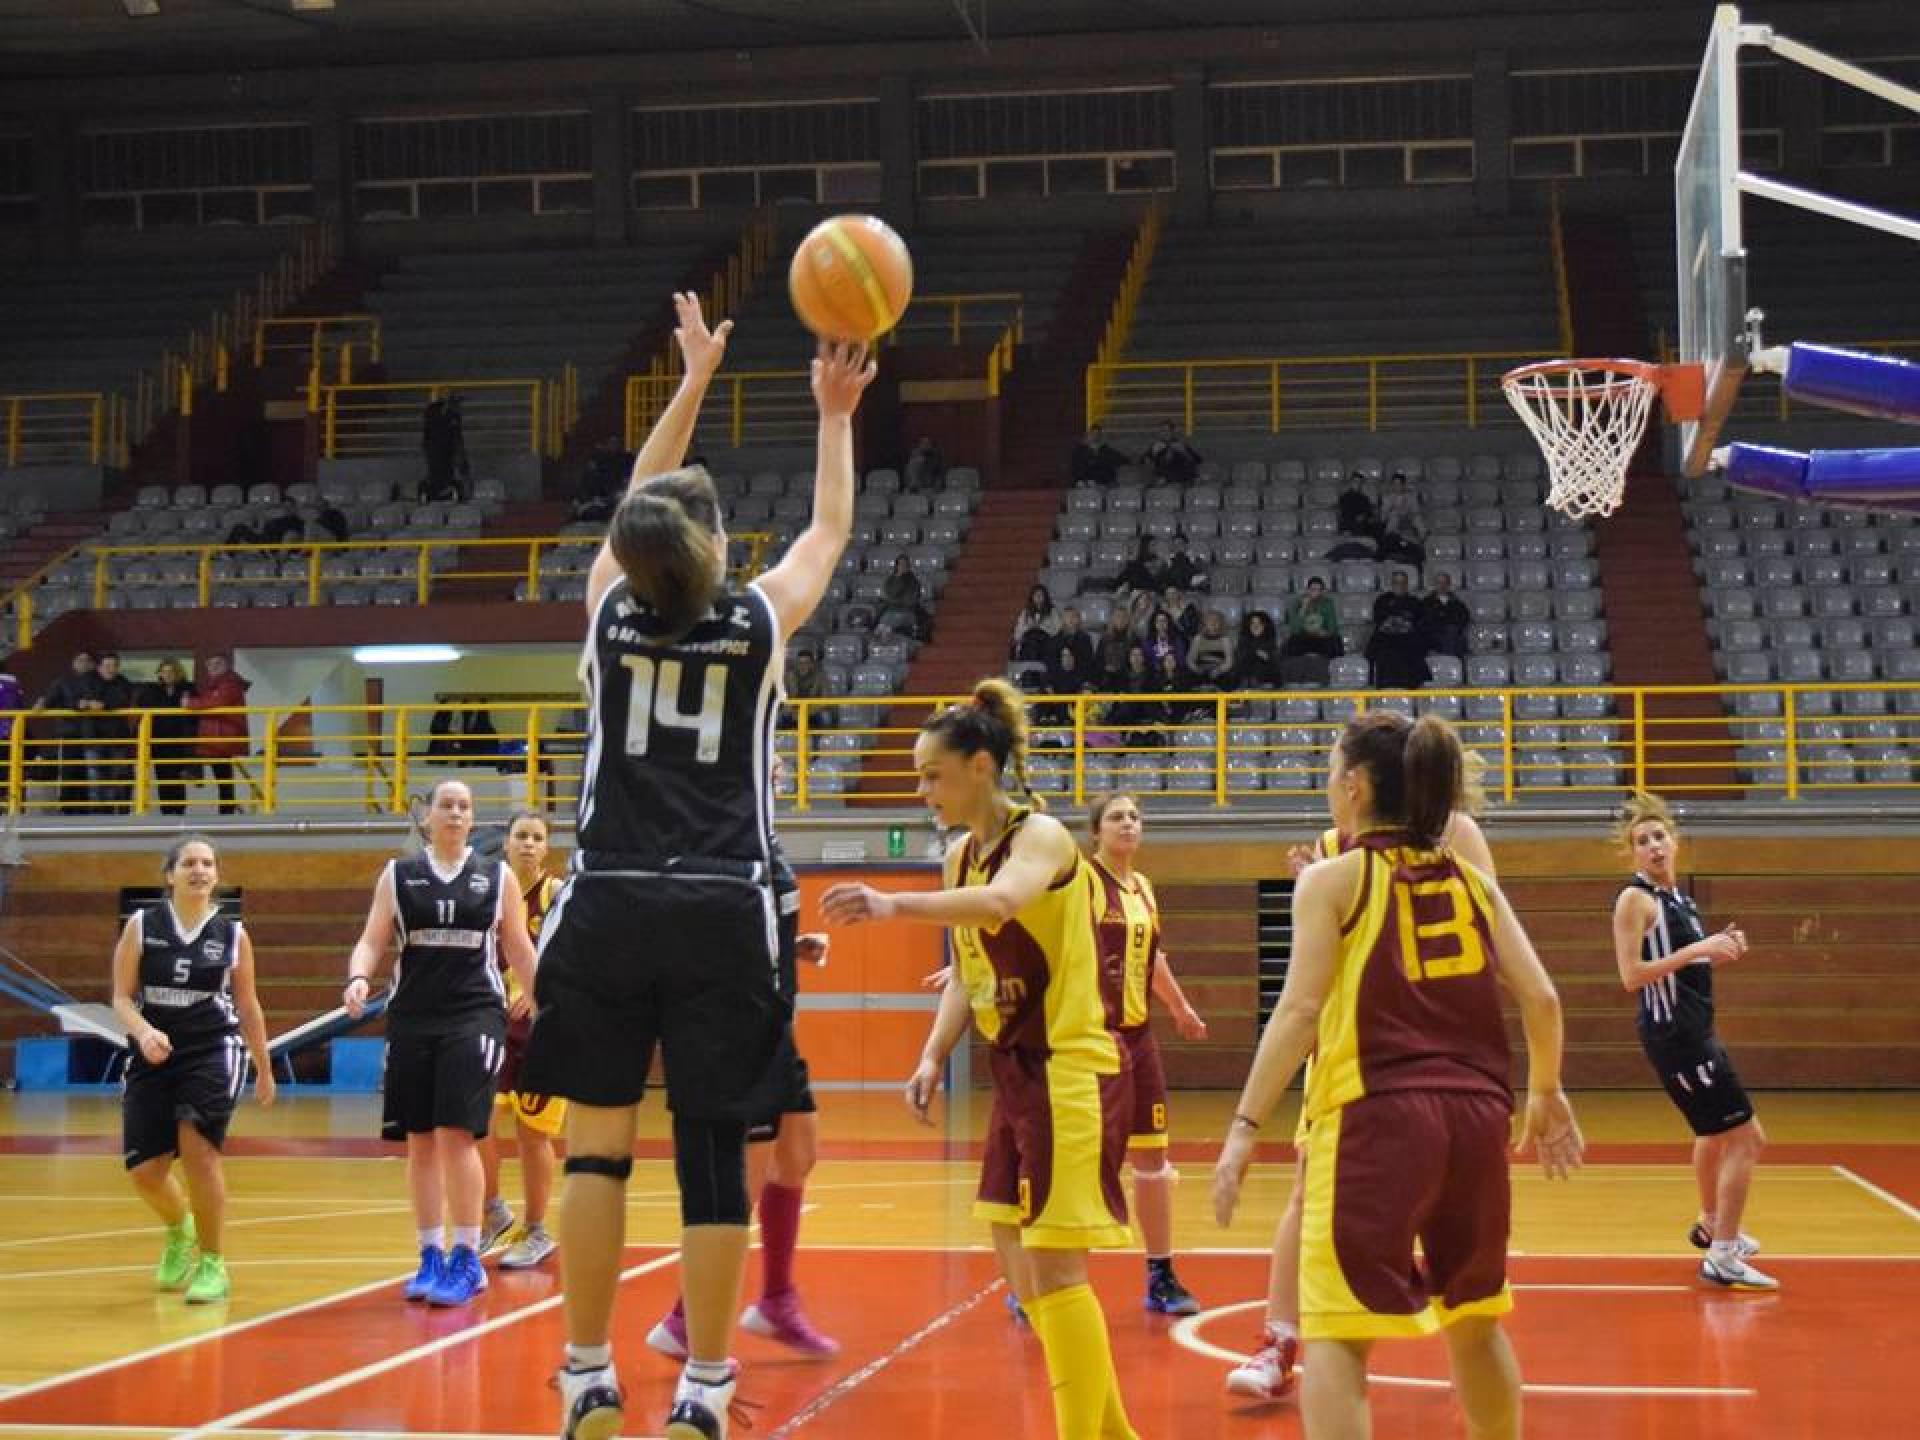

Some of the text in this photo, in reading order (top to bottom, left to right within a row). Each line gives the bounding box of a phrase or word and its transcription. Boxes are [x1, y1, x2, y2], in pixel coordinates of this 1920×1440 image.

[619, 654, 729, 763] 14
[436, 899, 457, 925] 11
[1394, 876, 1487, 983] 13
[173, 958, 193, 984] 5
